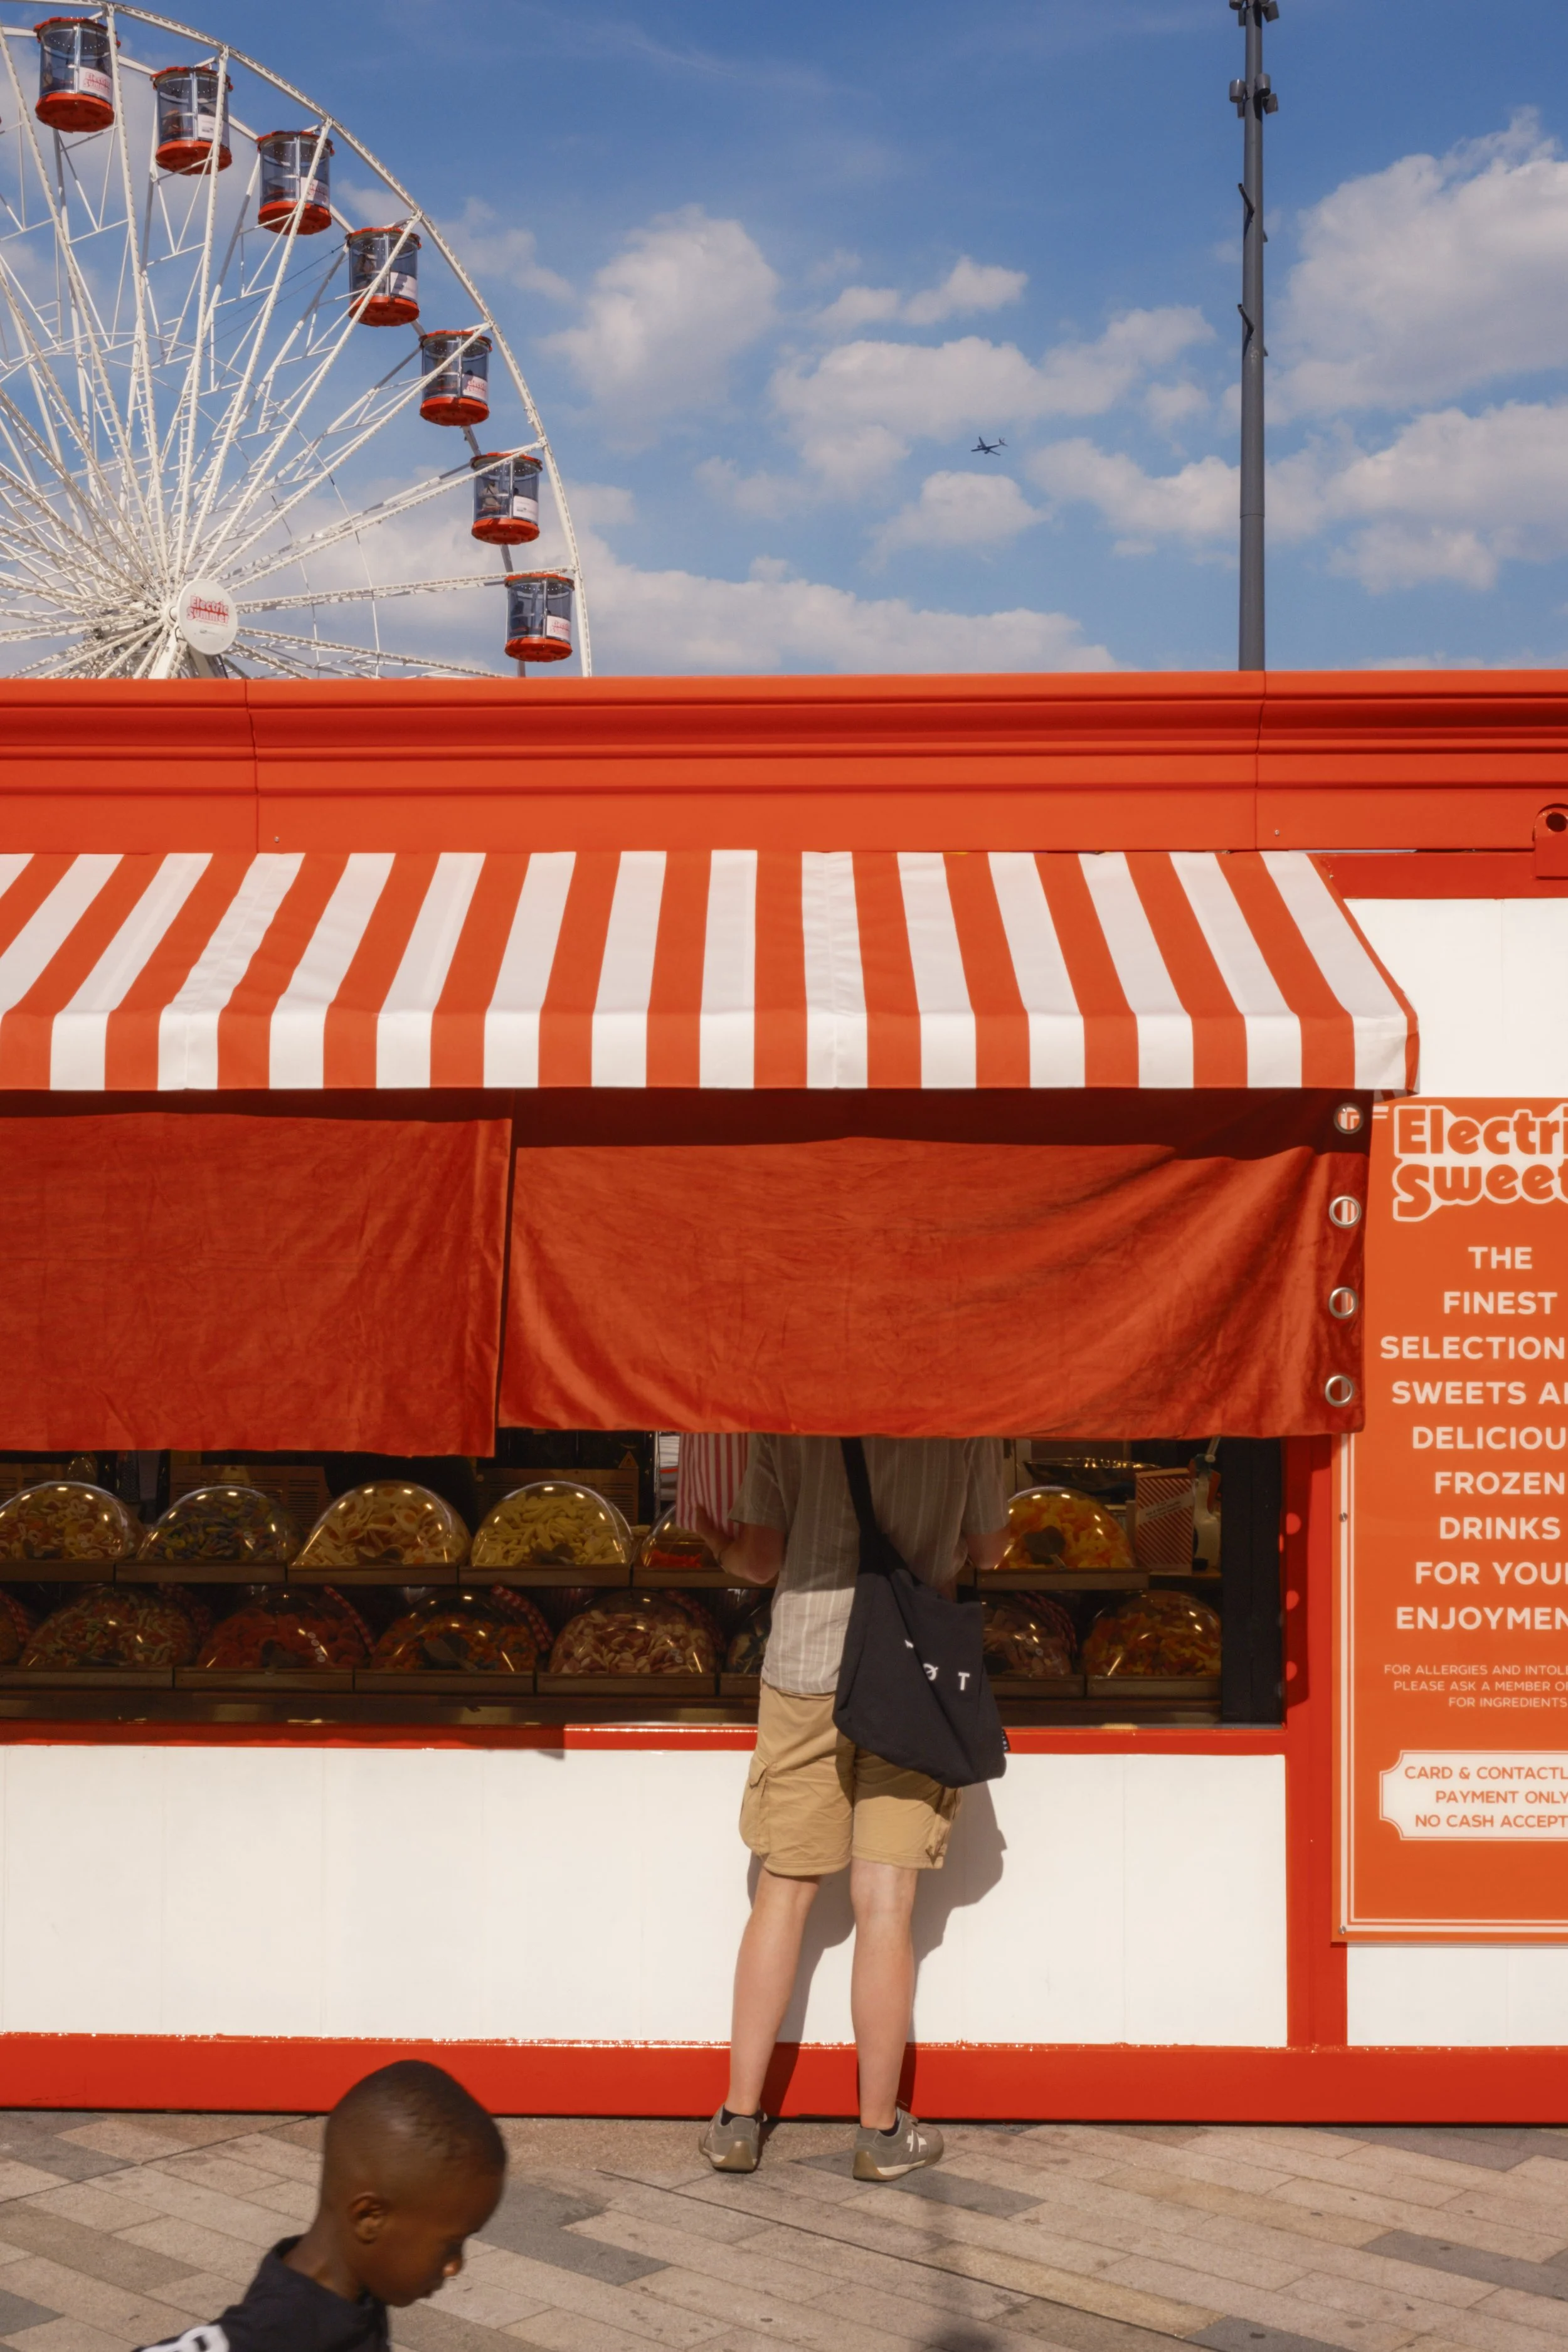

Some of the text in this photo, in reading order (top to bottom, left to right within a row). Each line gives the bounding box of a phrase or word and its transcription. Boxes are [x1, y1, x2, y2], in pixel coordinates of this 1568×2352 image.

[186, 607, 230, 624] Summer
[190, 595, 229, 614] Electric
[1468, 1247, 1532, 1269] THE
[1444, 1291, 1557, 1315] FINEST
[1381, 1336, 1565, 1359] SELECTION
[1392, 1381, 1568, 1404] SWEETS A
[1413, 1427, 1566, 1449] DELICIOU
[1435, 1472, 1565, 1495] FROZEN
[1440, 1517, 1560, 1539] DRINKS
[1416, 1562, 1568, 1585] FOR YOU
[1396, 1607, 1568, 1629] ENJOYMEN
[1384, 1665, 1568, 1675] FOR ALLERGIES AND INTOL
[1394, 1680, 1568, 1692] PLEASE ASK A MEMBER O
[1449, 1697, 1567, 1707] FOR INGREDIENTS
[1404, 1766, 1568, 1780] CARD & CONTACTL
[1436, 1791, 1568, 1804] PAYMENT ONLY
[1415, 1814, 1568, 1828] NO CASH ACCEPT
